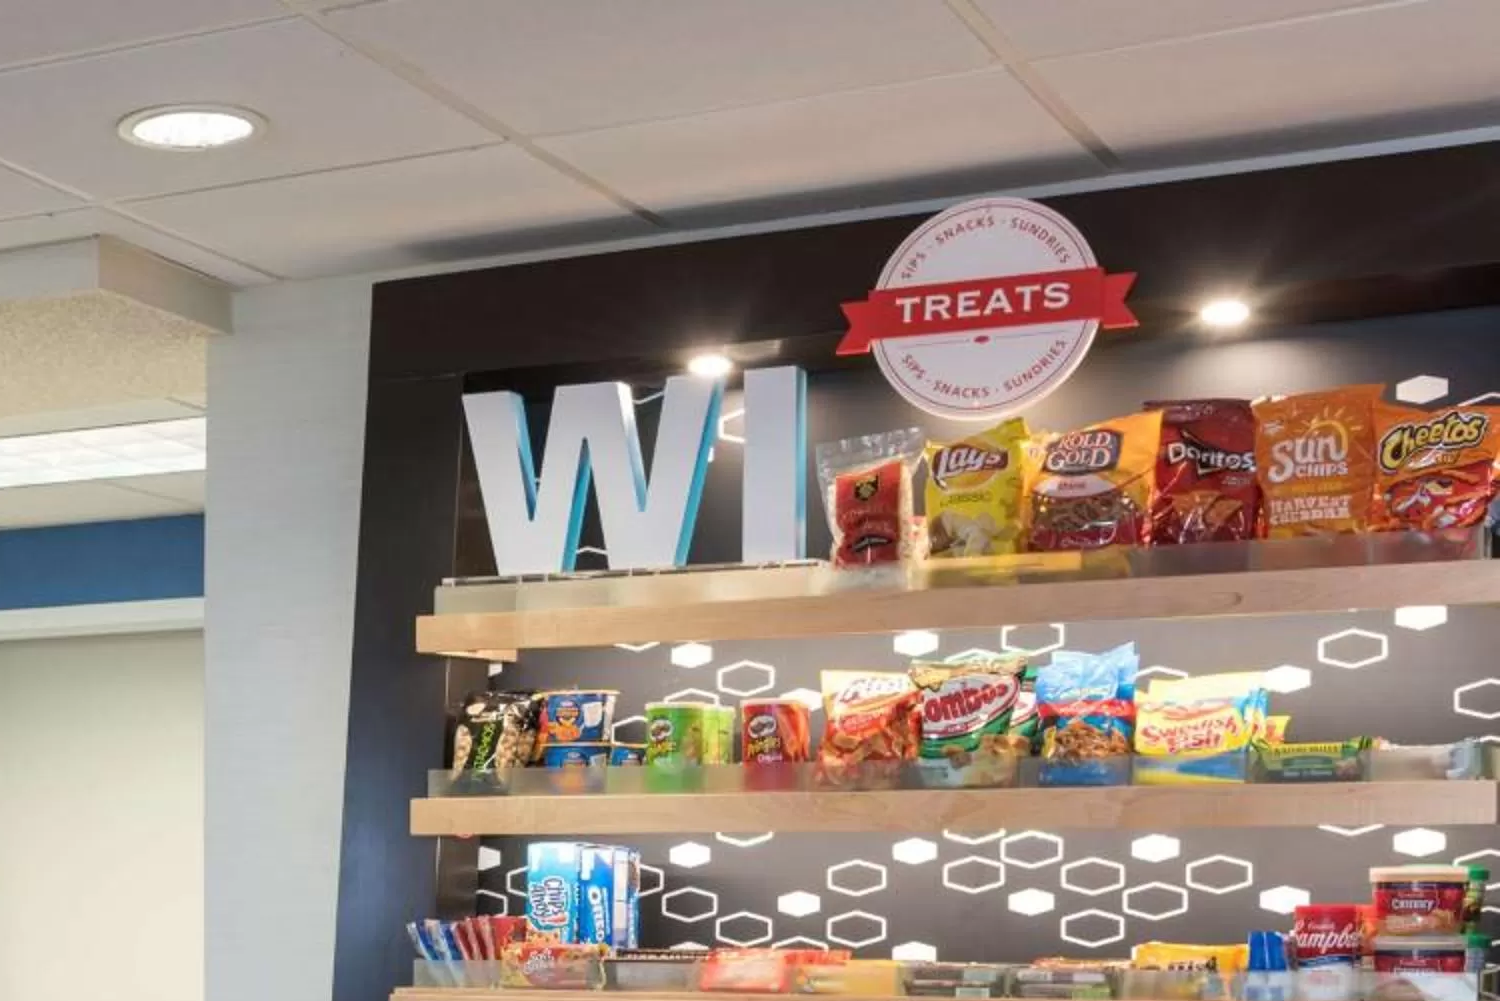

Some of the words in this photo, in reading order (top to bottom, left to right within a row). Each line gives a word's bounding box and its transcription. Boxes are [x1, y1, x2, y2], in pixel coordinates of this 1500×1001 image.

[901, 251, 926, 280] SIPS
[935, 215, 996, 246] SNACKS
[1009, 216, 1072, 265] SUNDRIES
[895, 281, 1072, 324] TREATS
[901, 353, 926, 380] SIPS
[932, 379, 991, 400] SNACKS
[1003, 339, 1068, 393] SUNDRIES
[1046, 448, 1111, 470] GOLD
[1167, 442, 1257, 473] Doritos
[1268, 432, 1349, 483] Sun
[1380, 412, 1485, 471] Cheetos
[1295, 461, 1349, 478] CHIPS
